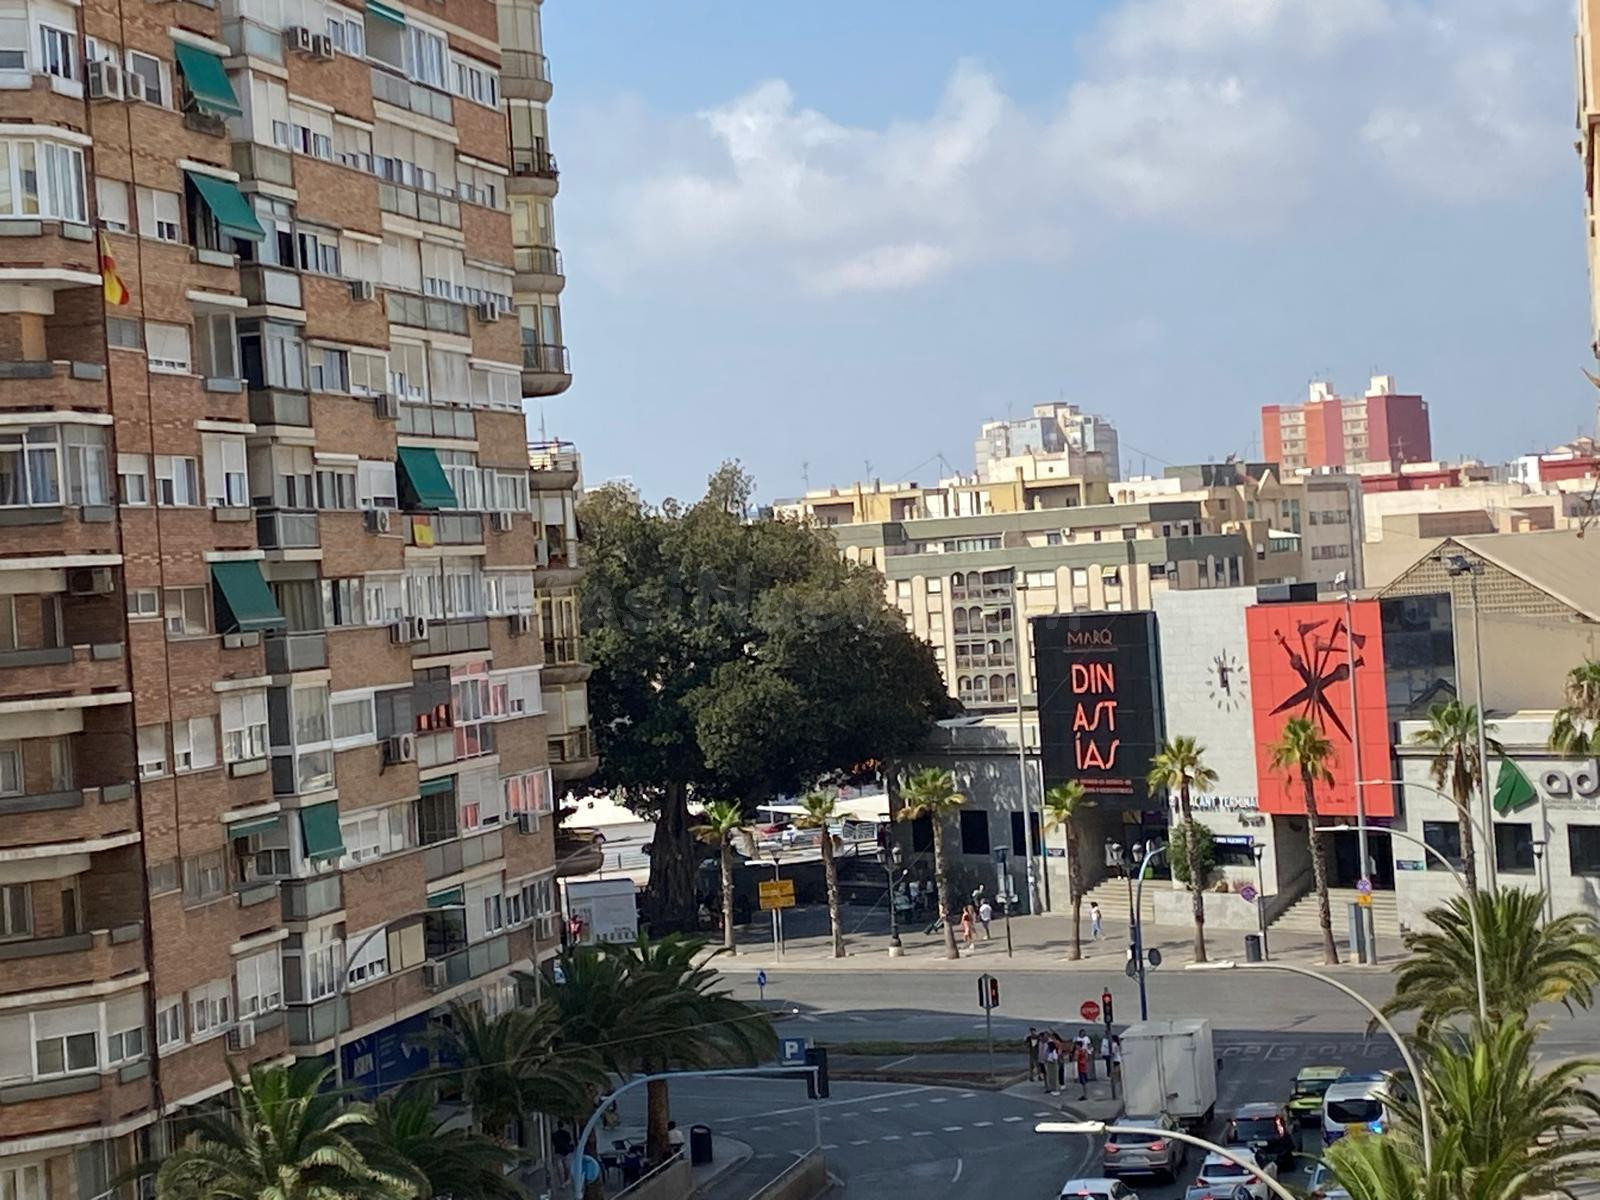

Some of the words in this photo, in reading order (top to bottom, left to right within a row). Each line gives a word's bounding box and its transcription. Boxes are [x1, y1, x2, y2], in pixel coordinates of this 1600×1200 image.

[1067, 628, 1112, 645] MARQ
[1072, 664, 1114, 694] DIN
[1073, 700, 1117, 731] AST
[1075, 732, 1120, 769] ÍAS
[785, 1041, 799, 1059] P
